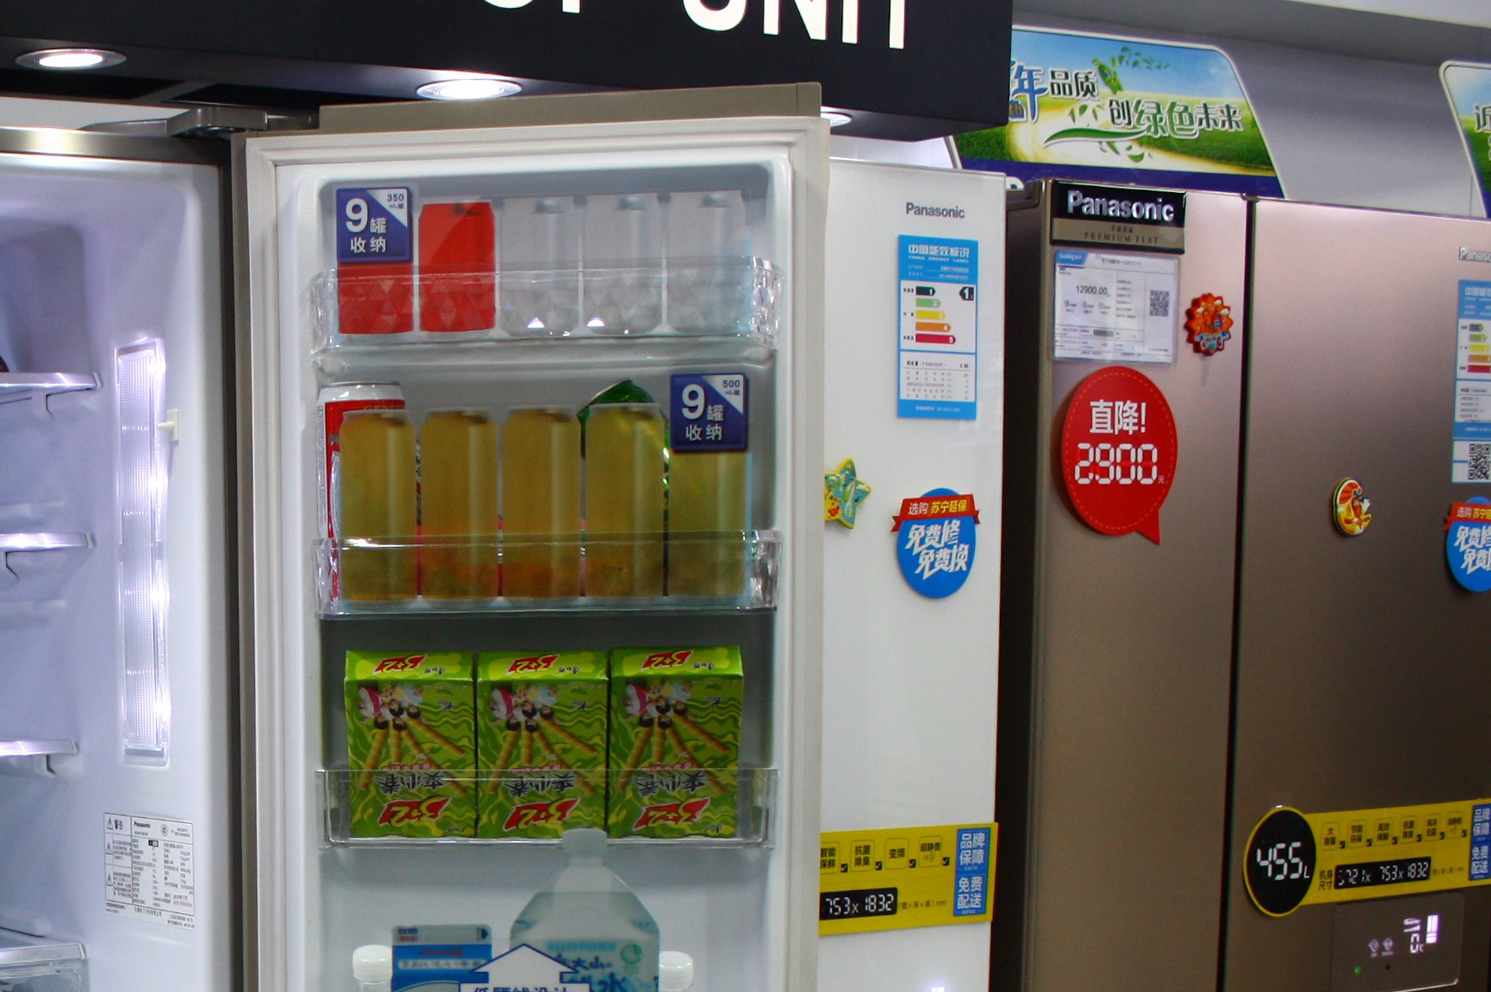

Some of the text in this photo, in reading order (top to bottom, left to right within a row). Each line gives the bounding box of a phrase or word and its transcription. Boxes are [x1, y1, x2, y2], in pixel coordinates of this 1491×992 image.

[1109, 99, 1245, 139] 创绿色未来
[387, 194, 404, 202] 350
[1067, 190, 1175, 222] Panasonic
[906, 202, 965, 219] Panasonic
[351, 237, 386, 254] 收纳
[1084, 232, 1160, 244] PREMIUM FLAT
[723, 380, 740, 388] 500
[1089, 399, 1147, 435] 直降!
[685, 424, 723, 441] 收纳
[1074, 443, 1158, 485] 2900
[930, 499, 968, 514] 苏宁延保
[904, 519, 961, 556] 免费修
[914, 543, 970, 580] 免费换
[961, 832, 985, 849] 品牌
[960, 849, 985, 866] 保障
[958, 876, 983, 892] 免费
[864, 893, 895, 913] 1832
[957, 892, 982, 909] 配送
